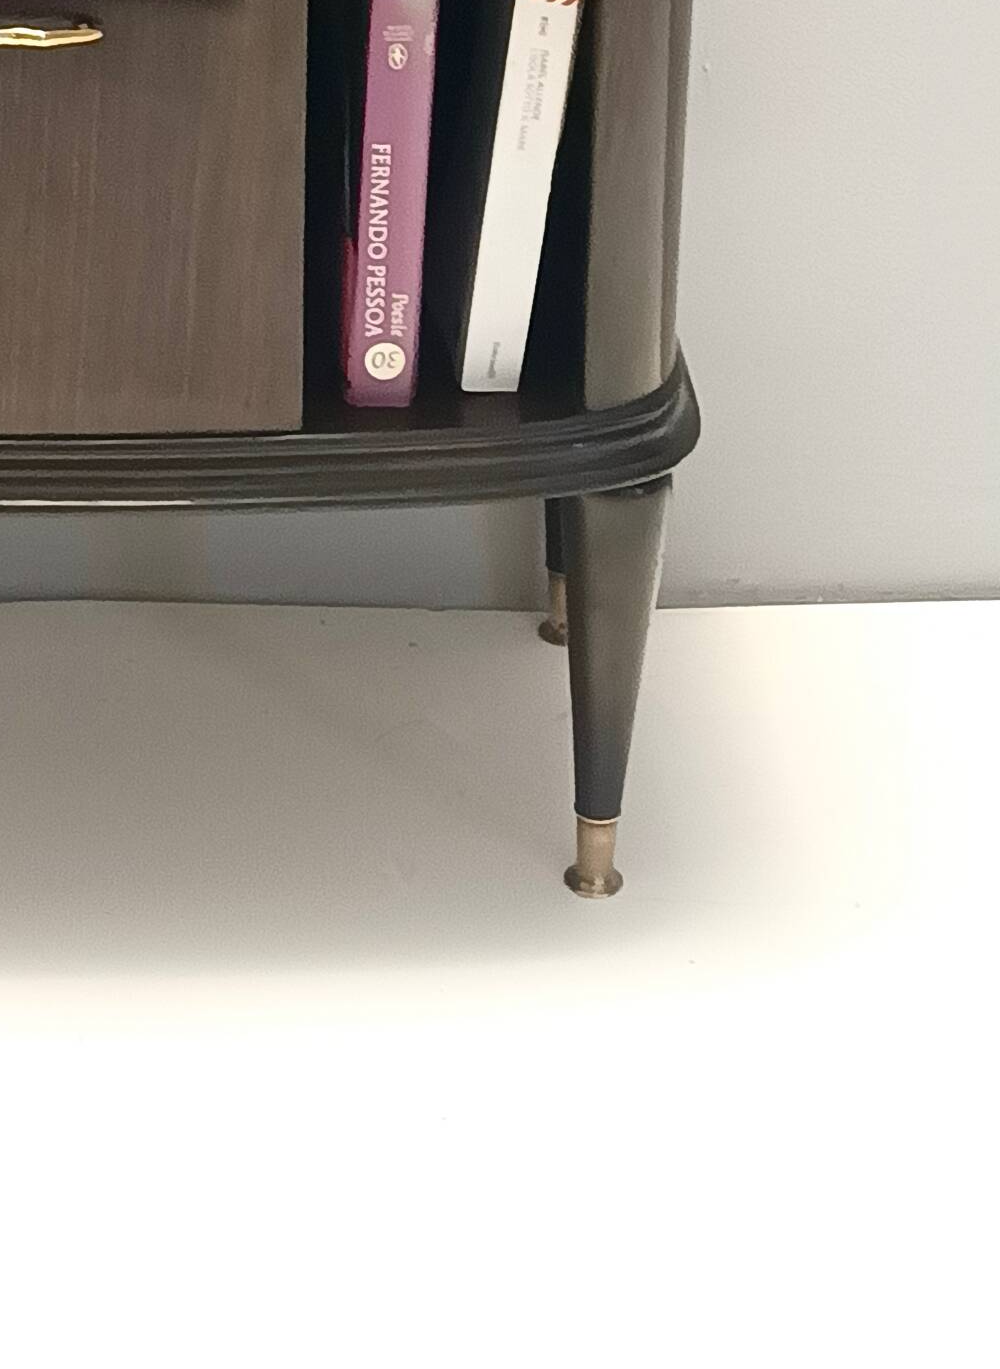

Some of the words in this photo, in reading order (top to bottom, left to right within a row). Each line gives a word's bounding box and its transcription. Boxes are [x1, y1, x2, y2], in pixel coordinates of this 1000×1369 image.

[369, 143, 391, 260] FERNANDO
[364, 264, 387, 338] PESSOA
[390, 292, 409, 338] Poesie
[371, 350, 401, 370] 30
